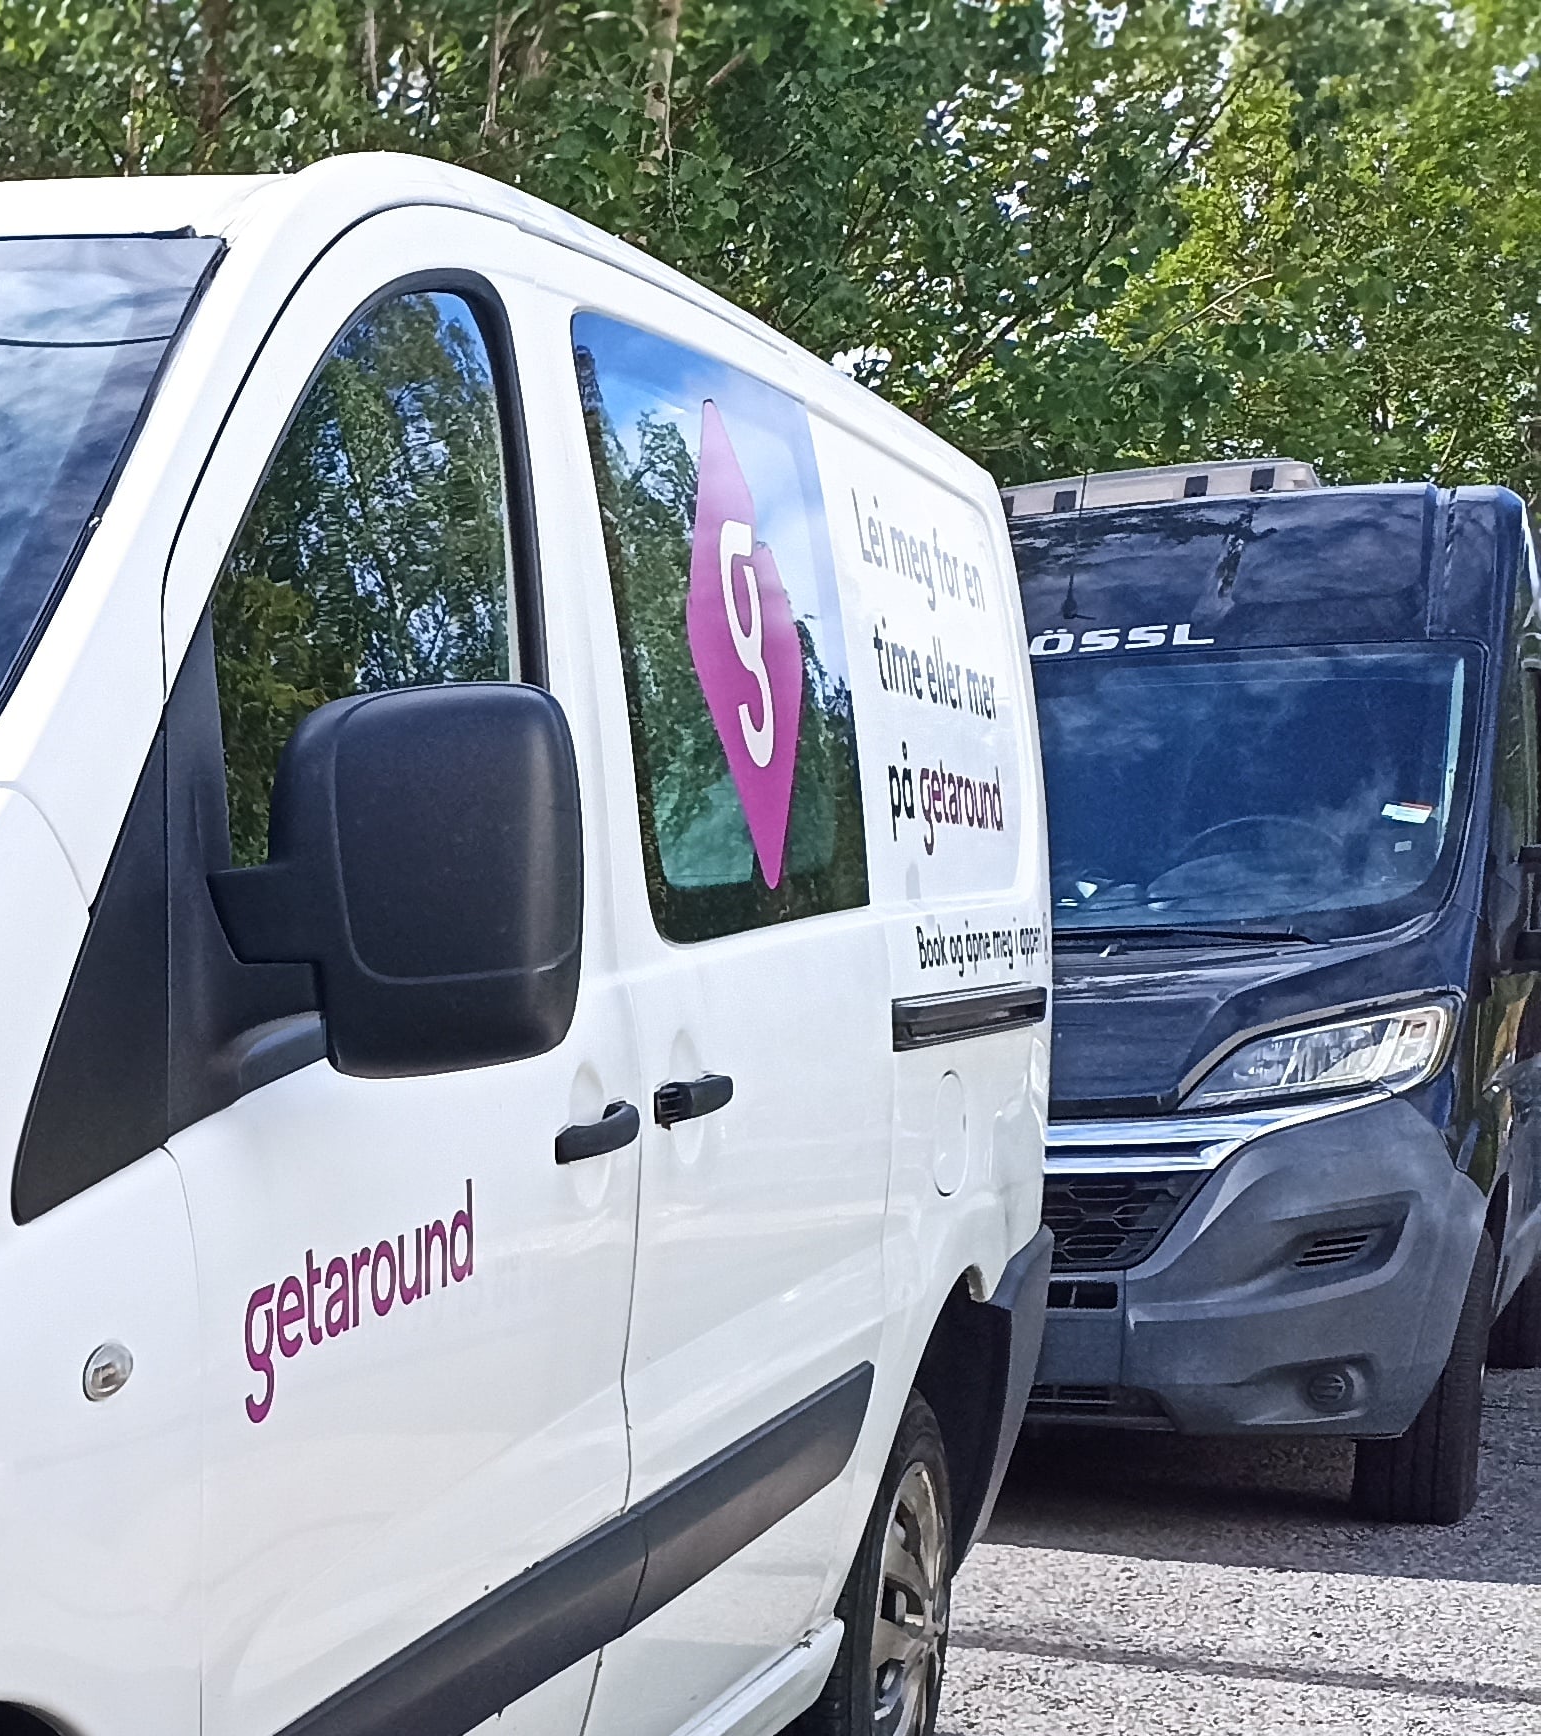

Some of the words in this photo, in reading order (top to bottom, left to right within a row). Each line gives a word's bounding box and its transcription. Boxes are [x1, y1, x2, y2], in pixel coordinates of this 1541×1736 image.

[851, 487, 888, 569] Lei
[890, 526, 936, 611] meg
[933, 527, 961, 600] for
[963, 561, 986, 612] en
[873, 616, 923, 700] time
[926, 635, 963, 710] eller
[966, 668, 996, 720] mer
[1029, 623, 1215, 656] ÖSSL
[887, 741, 915, 842] på
[920, 759, 1004, 856] getaround
[916, 924, 949, 969] Book
[950, 935, 965, 977] og
[992, 930, 1014, 970] meg
[1012, 917, 1018, 955] i
[244, 1178, 474, 1424] getaround
